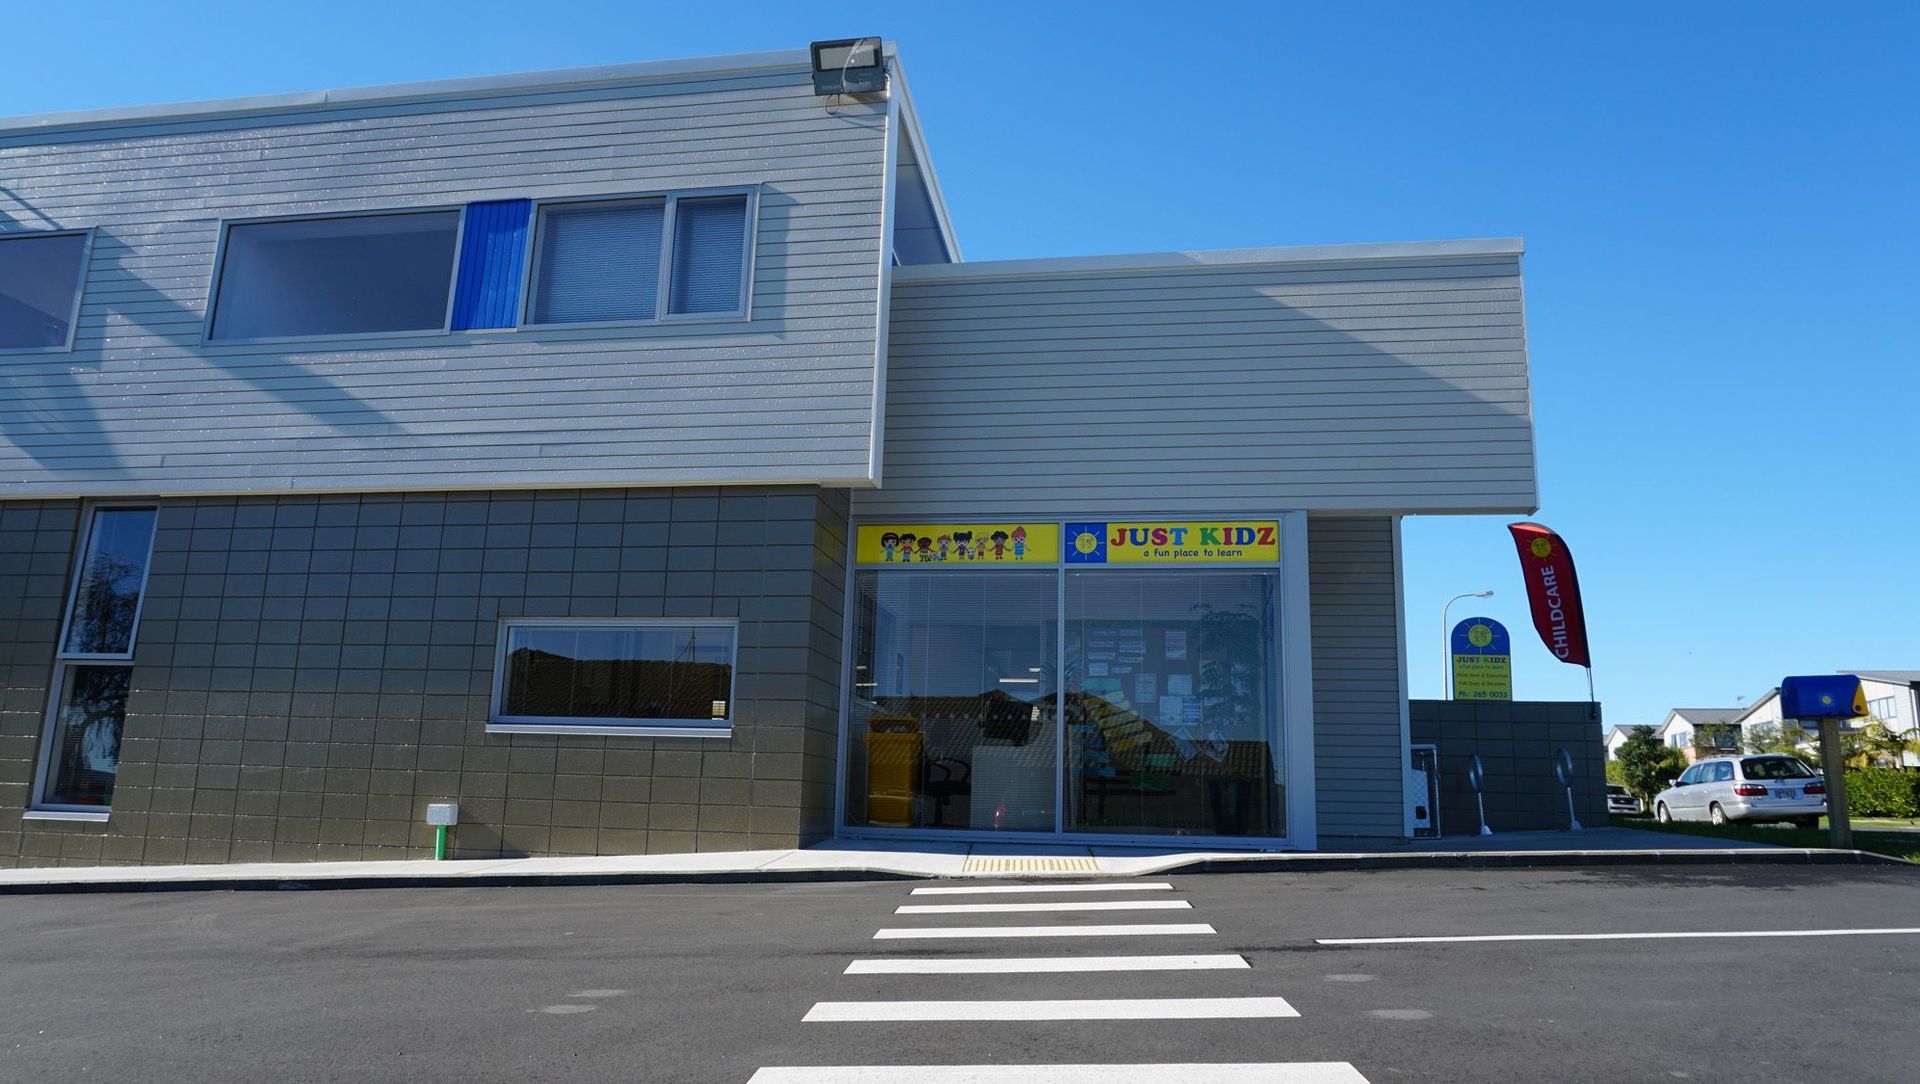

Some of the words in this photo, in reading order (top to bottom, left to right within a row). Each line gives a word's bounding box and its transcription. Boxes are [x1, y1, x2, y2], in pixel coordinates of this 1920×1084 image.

[1110, 527, 1188, 546] JUST
[1200, 527, 1276, 546] KIDZ
[1154, 548, 1170, 557] fun
[1174, 548, 1199, 559] place
[1204, 549, 1213, 557] to
[1217, 548, 1243, 557] learn
[1541, 565, 1569, 658] CHILDCARE
